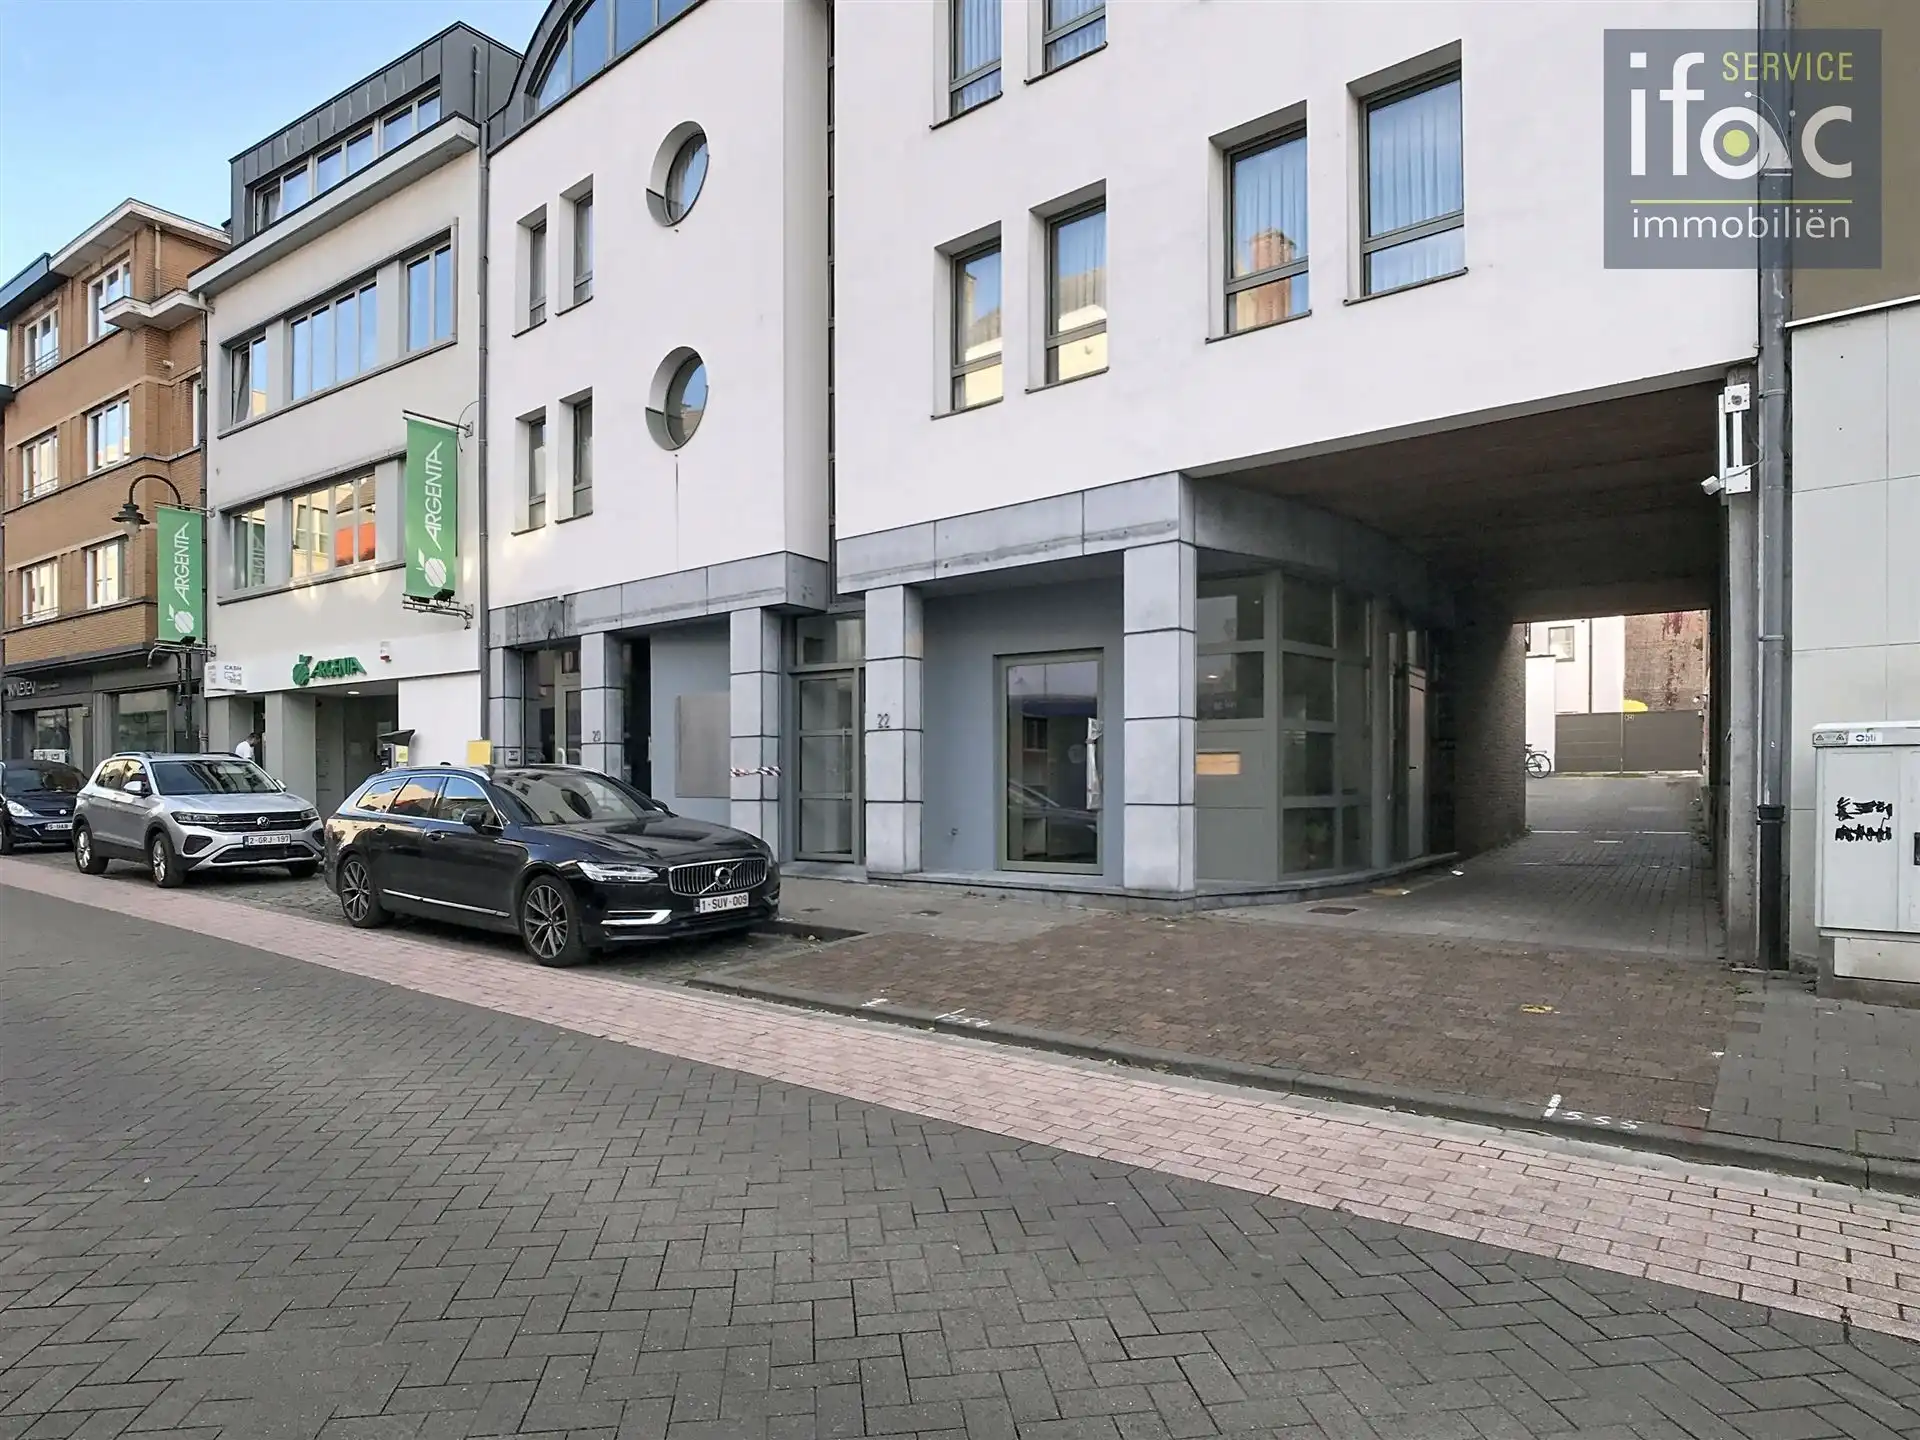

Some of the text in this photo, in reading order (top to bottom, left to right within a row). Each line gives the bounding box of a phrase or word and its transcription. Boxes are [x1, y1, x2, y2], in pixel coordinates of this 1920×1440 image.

[424, 440, 443, 551] ARGENTA
[173, 521, 190, 606] ARGENTA
[310, 656, 368, 679] ARGENTA
[877, 713, 890, 729] 22
[701, 894, 748, 911] 1-SUV-009
